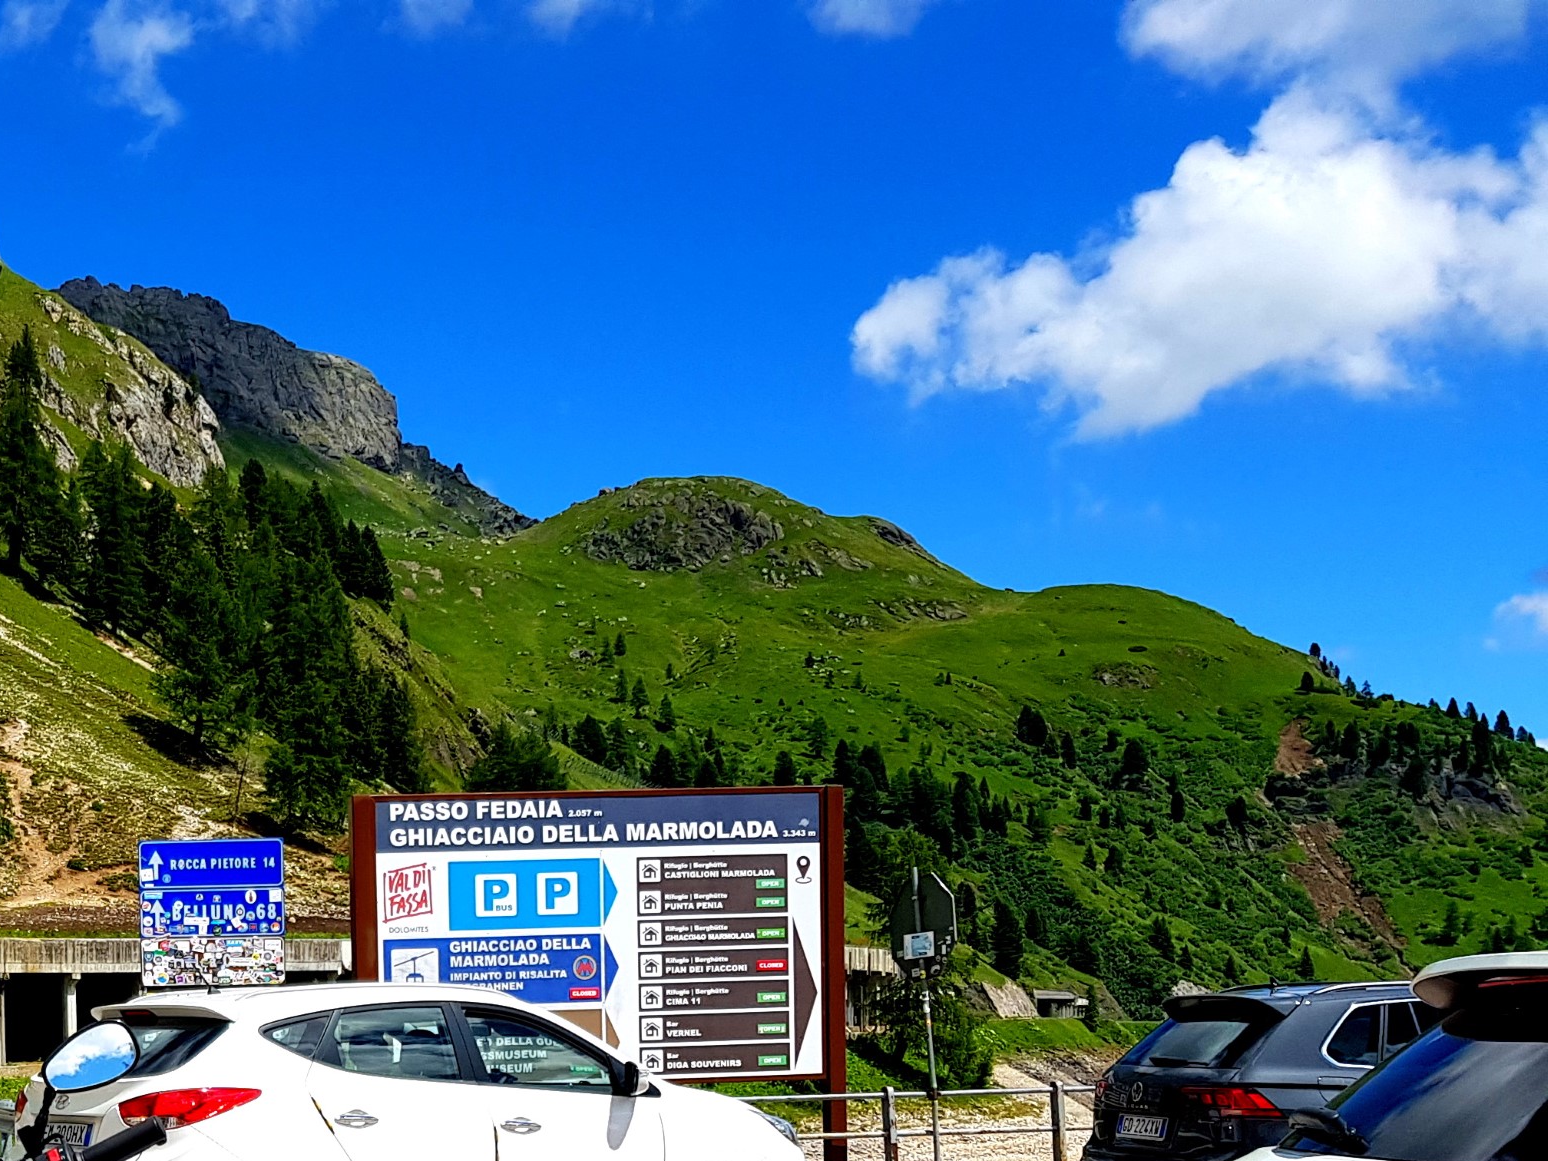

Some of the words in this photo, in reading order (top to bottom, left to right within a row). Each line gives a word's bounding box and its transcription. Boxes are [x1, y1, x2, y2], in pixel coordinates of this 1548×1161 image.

[389, 801, 469, 821] PASSO
[476, 800, 563, 819] FEDAIA
[568, 808, 592, 818] 2.057
[594, 809, 603, 817] m
[390, 825, 535, 847] GHIACCIAIO
[542, 823, 620, 843] DELLA
[626, 821, 779, 842] MARMOLADA
[782, 829, 806, 838] 3.343
[170, 858, 207, 870] ROCCA
[210, 857, 257, 869] PIETORE
[263, 857, 276, 868] 14
[664, 870, 720, 879] CASTIGLIONI
[721, 868, 776, 878] MARMOLADA
[483, 879, 510, 911] P
[545, 877, 571, 910] P
[388, 889, 428, 916] FASSA
[664, 902, 694, 911] PUNTA
[696, 901, 724, 910] PENIA
[256, 903, 277, 920] 68
[388, 926, 429, 934] DOLOMITES
[449, 939, 537, 953] GHIACCIAO
[542, 938, 592, 951] DELLA
[450, 953, 550, 968] MARMOLADA
[665, 965, 687, 974] PIAN
[689, 965, 704, 973] DEI
[705, 963, 748, 973] FIACCONI
[450, 971, 503, 982] IMPIANTO
[505, 970, 517, 980] DI
[519, 969, 568, 979] RISALITA
[665, 998, 689, 1006] CIMA
[690, 997, 701, 1005] 11
[666, 1020, 679, 1028] Bar
[666, 1029, 702, 1037] VERNEL
[496, 1036, 534, 1048] DELLA
[666, 1061, 689, 1069] DIGA
[690, 1059, 742, 1068] SOUVENIRS
